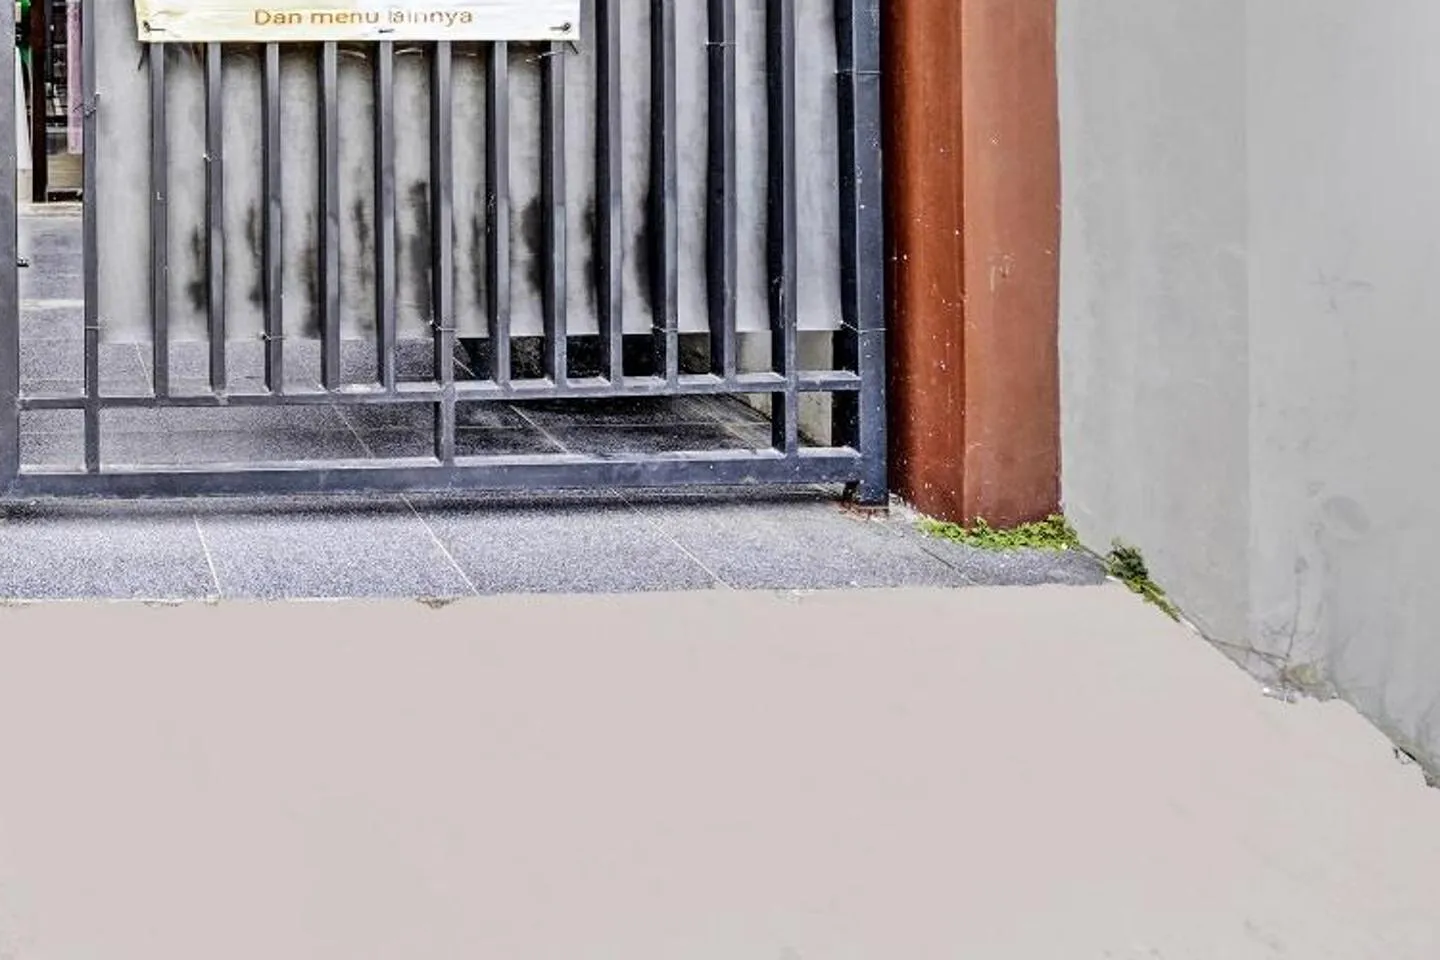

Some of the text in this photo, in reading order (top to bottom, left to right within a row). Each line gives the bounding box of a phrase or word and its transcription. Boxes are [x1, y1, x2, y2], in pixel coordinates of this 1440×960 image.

[254, 8, 473, 27] Dan menu lainnya
